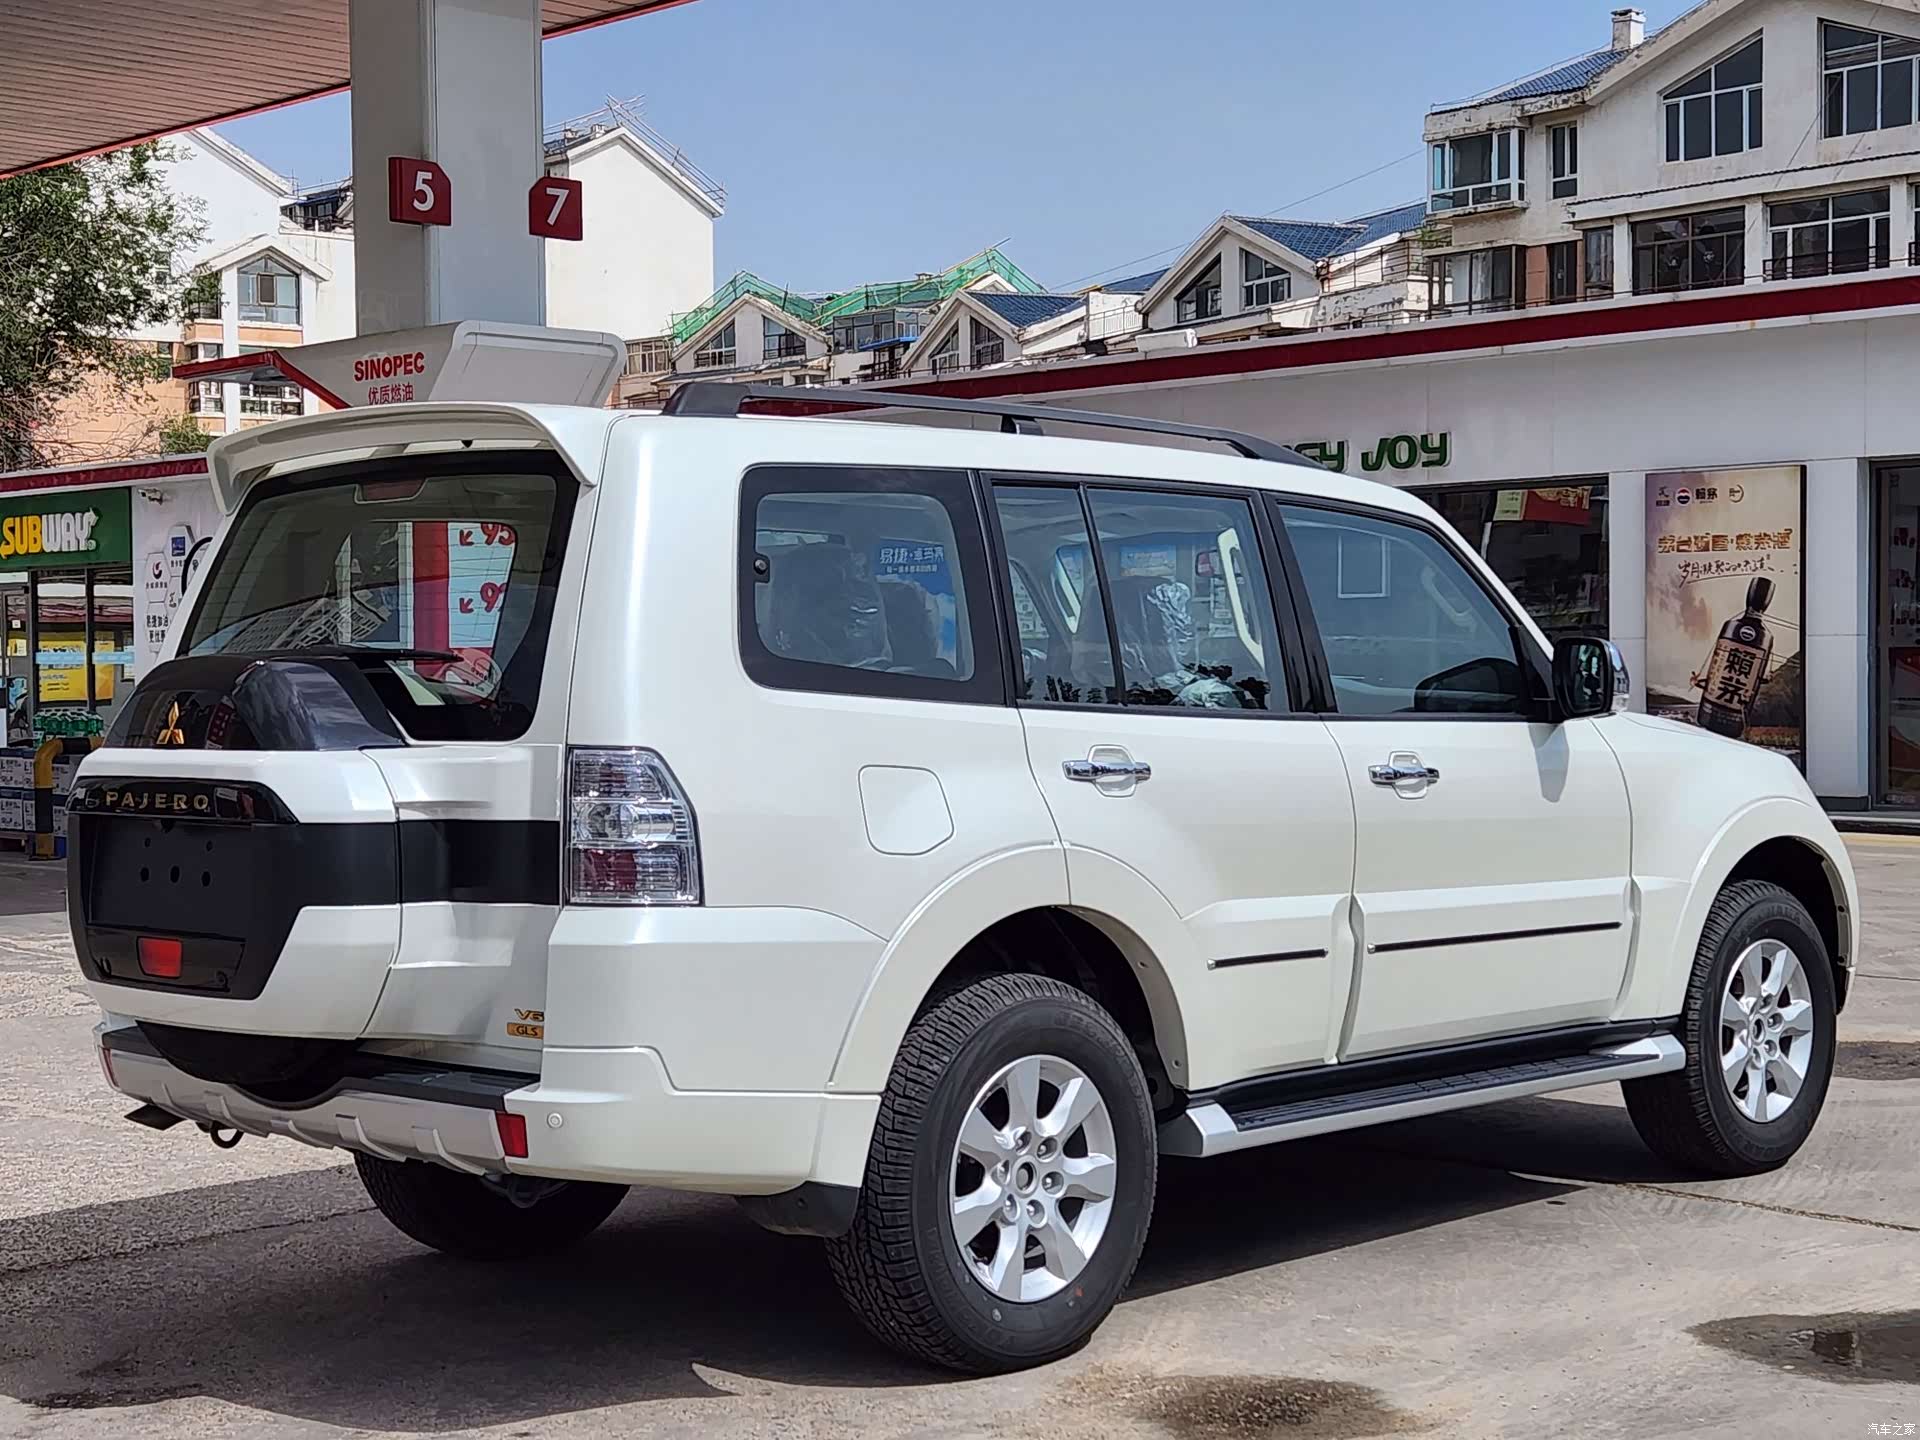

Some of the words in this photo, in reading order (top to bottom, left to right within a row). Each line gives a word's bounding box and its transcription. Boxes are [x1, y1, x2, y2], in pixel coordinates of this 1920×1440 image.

[412, 170, 435, 212] 5
[545, 187, 570, 226] 7
[354, 351, 425, 382] SINOPEC
[368, 381, 414, 404] 优质燃油
[1360, 432, 1448, 472] JOY
[0, 507, 99, 560] SUBWAY
[105, 790, 209, 810] PAJERO
[514, 1008, 545, 1022] V6
[516, 1025, 538, 1037] GLS
